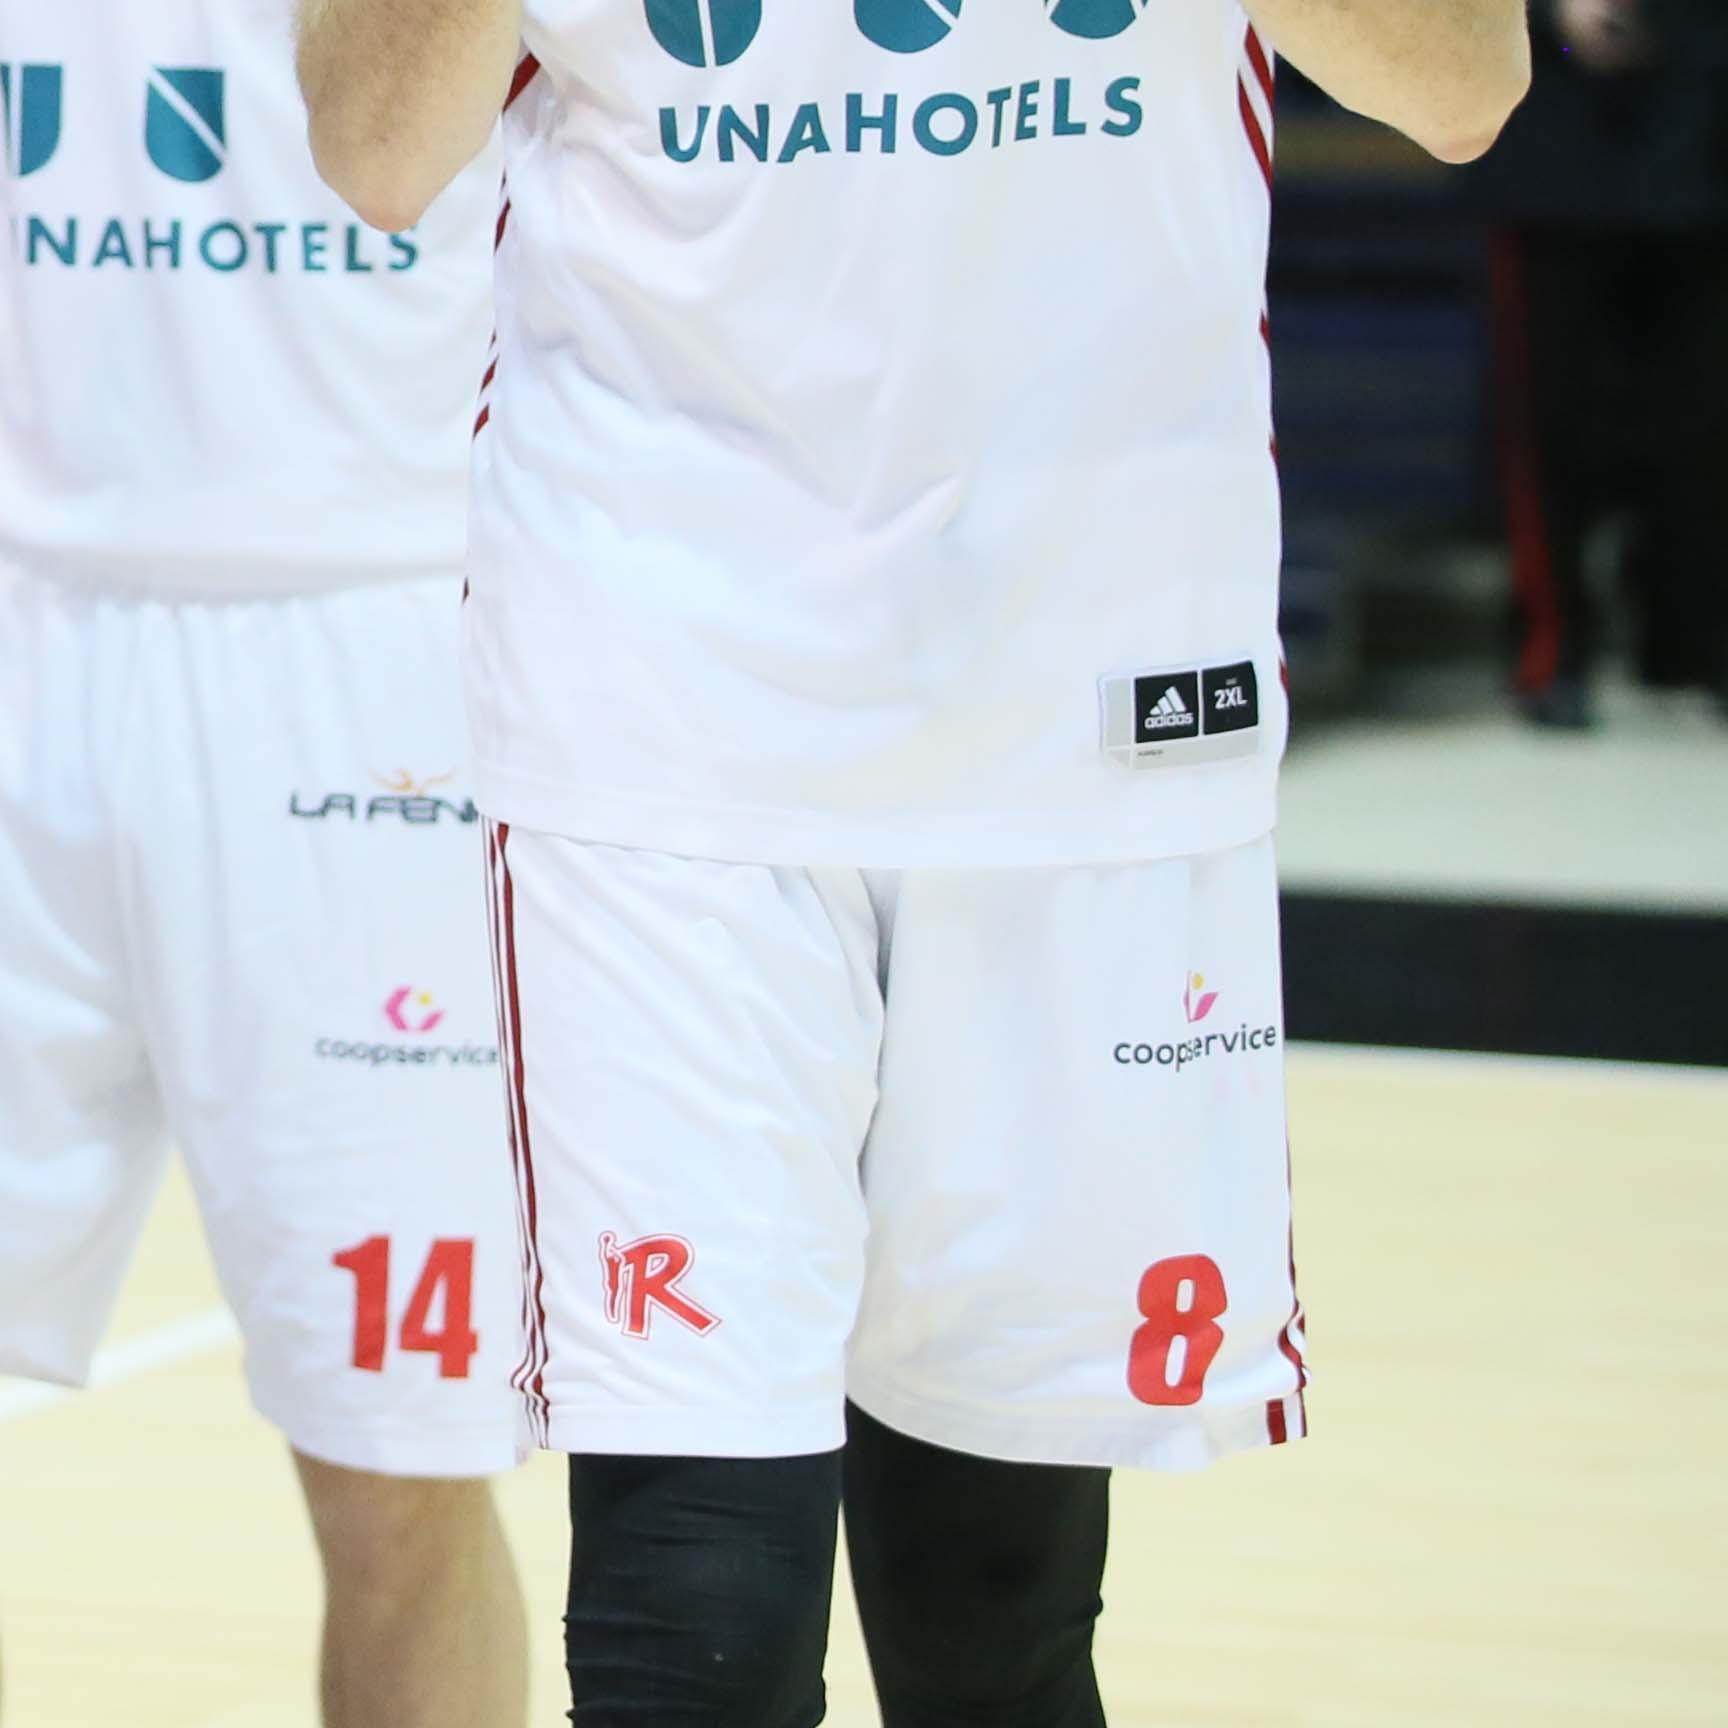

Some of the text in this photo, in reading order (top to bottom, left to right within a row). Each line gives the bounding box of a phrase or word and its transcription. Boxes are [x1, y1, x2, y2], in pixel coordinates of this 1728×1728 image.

[659, 76, 1144, 165] UNAHOTELS
[1145, 712, 1193, 729] adidas
[1214, 686, 1248, 710] 2XL
[1114, 1021, 1277, 1073] coopservice
[332, 1234, 479, 1378] 14
[1129, 1253, 1227, 1407] 8
